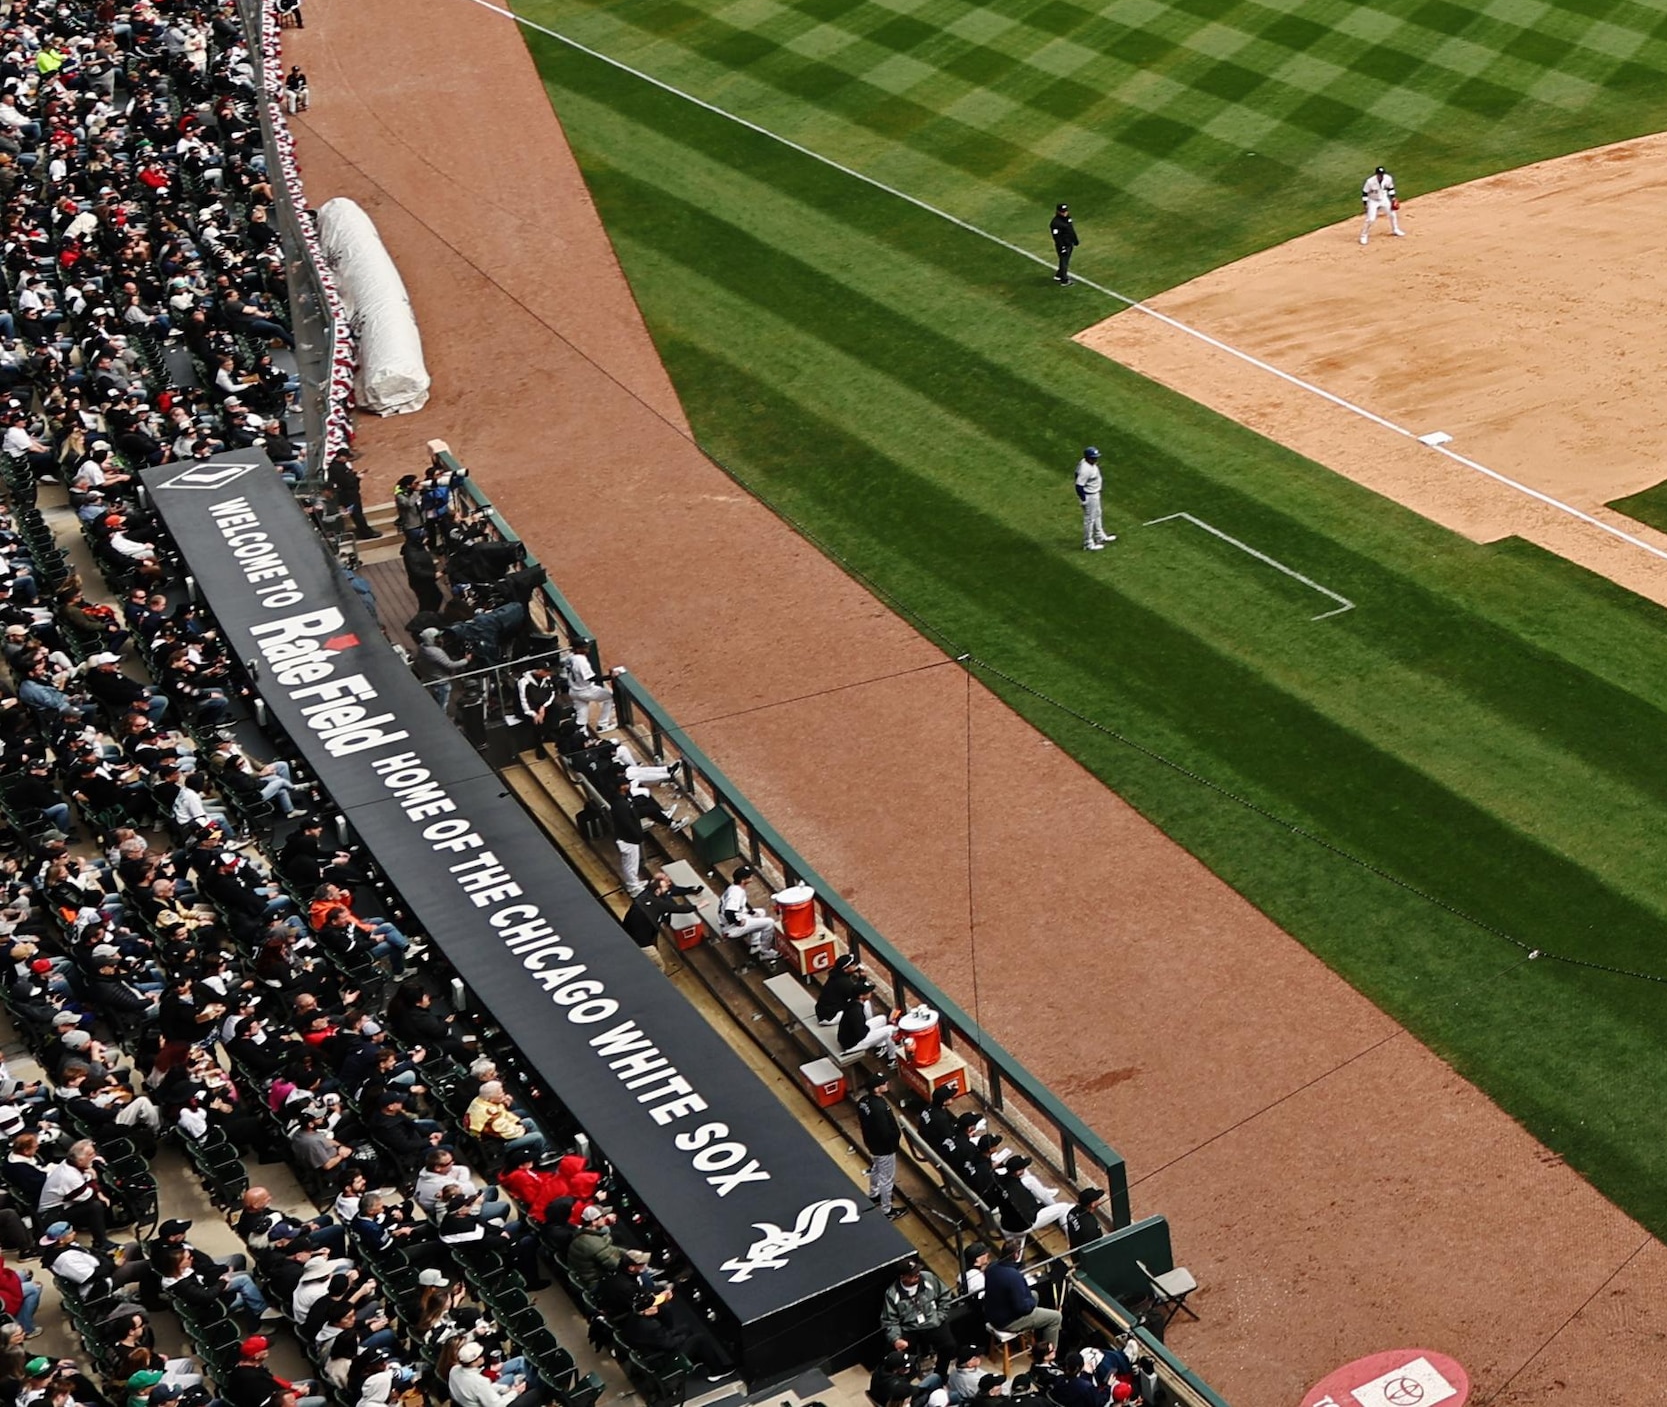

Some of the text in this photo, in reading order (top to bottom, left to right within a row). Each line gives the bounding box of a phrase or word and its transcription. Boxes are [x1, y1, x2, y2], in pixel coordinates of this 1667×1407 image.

[208, 496, 772, 1197] WELCOME TO Rate Field HOME OF THE CHICAGO WHITE SOX
